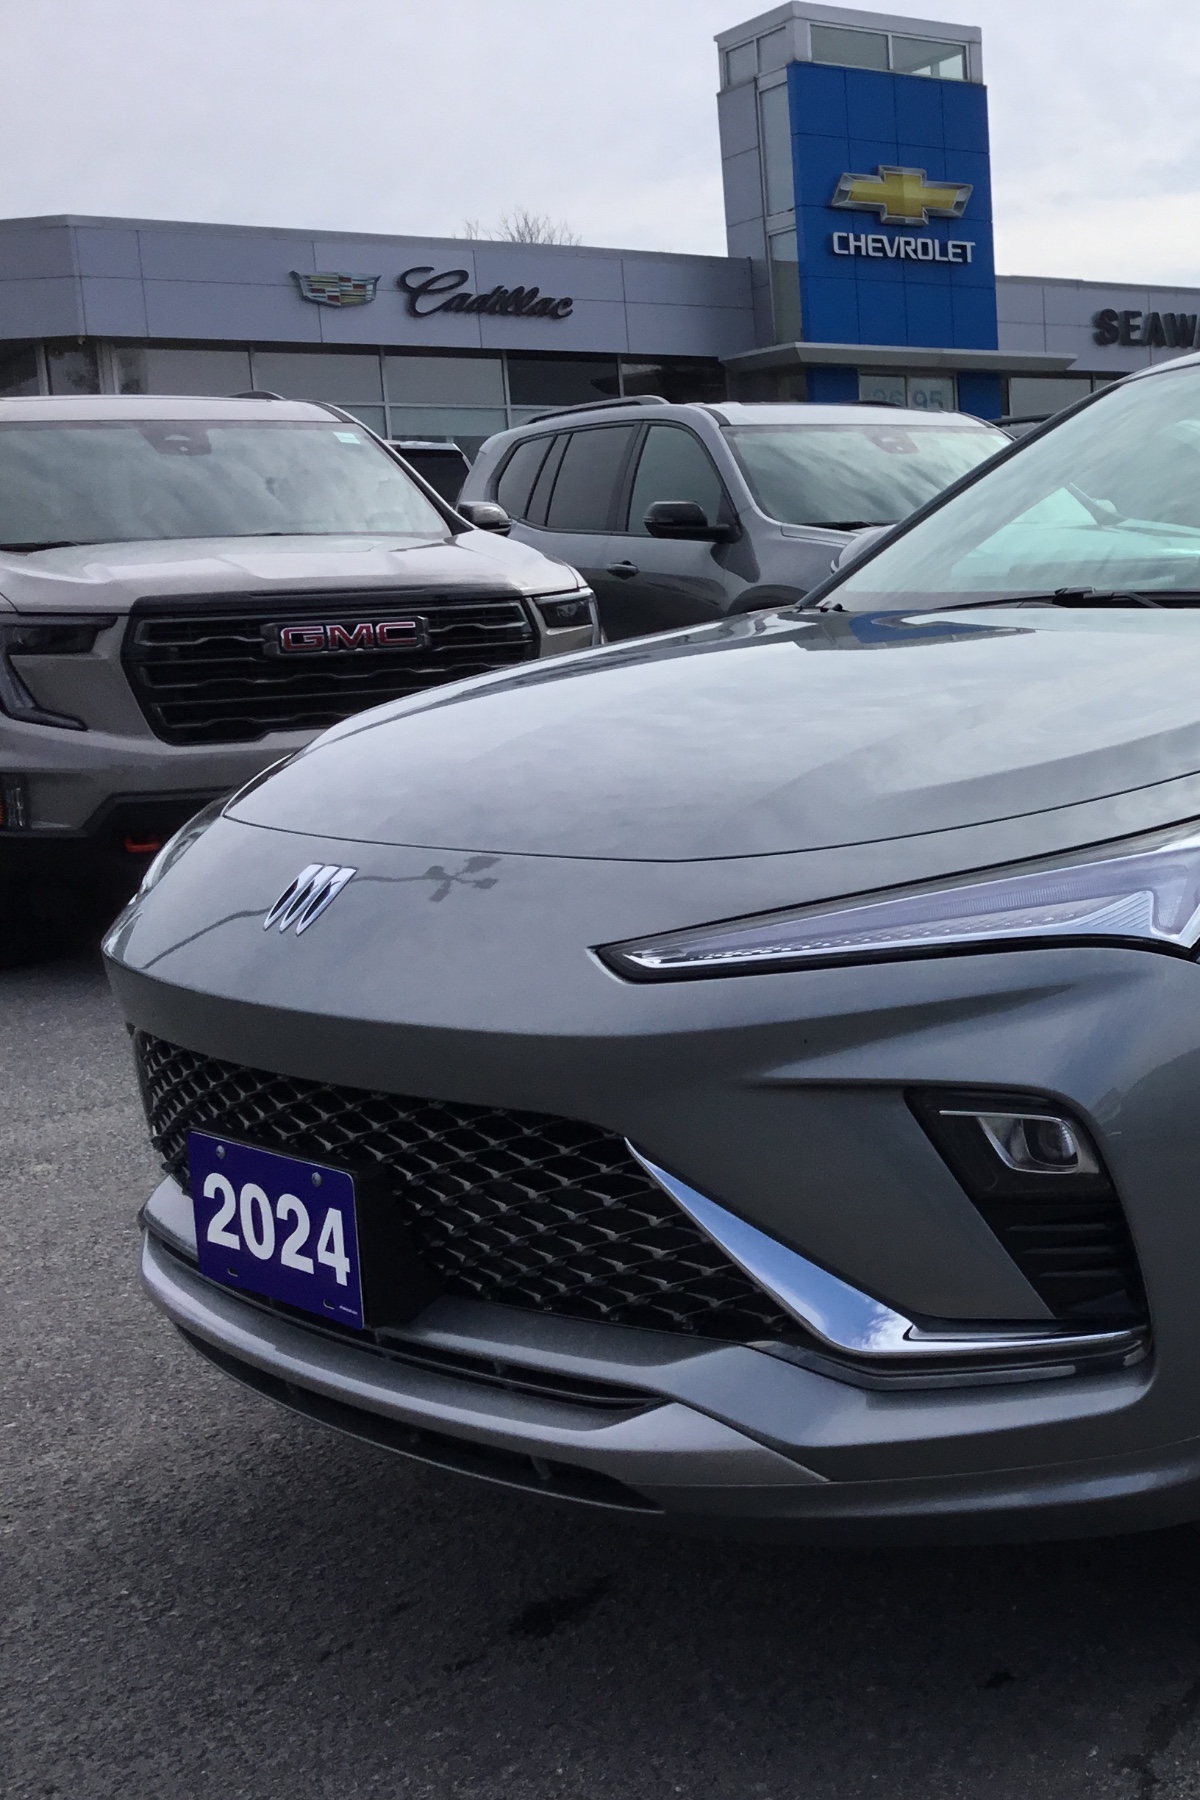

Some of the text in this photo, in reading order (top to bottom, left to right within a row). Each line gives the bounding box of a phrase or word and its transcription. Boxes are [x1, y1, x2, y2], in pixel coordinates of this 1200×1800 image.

[832, 231, 976, 263] CHEVROLET
[397, 266, 573, 319] Cadillac
[280, 621, 417, 651] GMC
[203, 1172, 350, 1287] 2024
